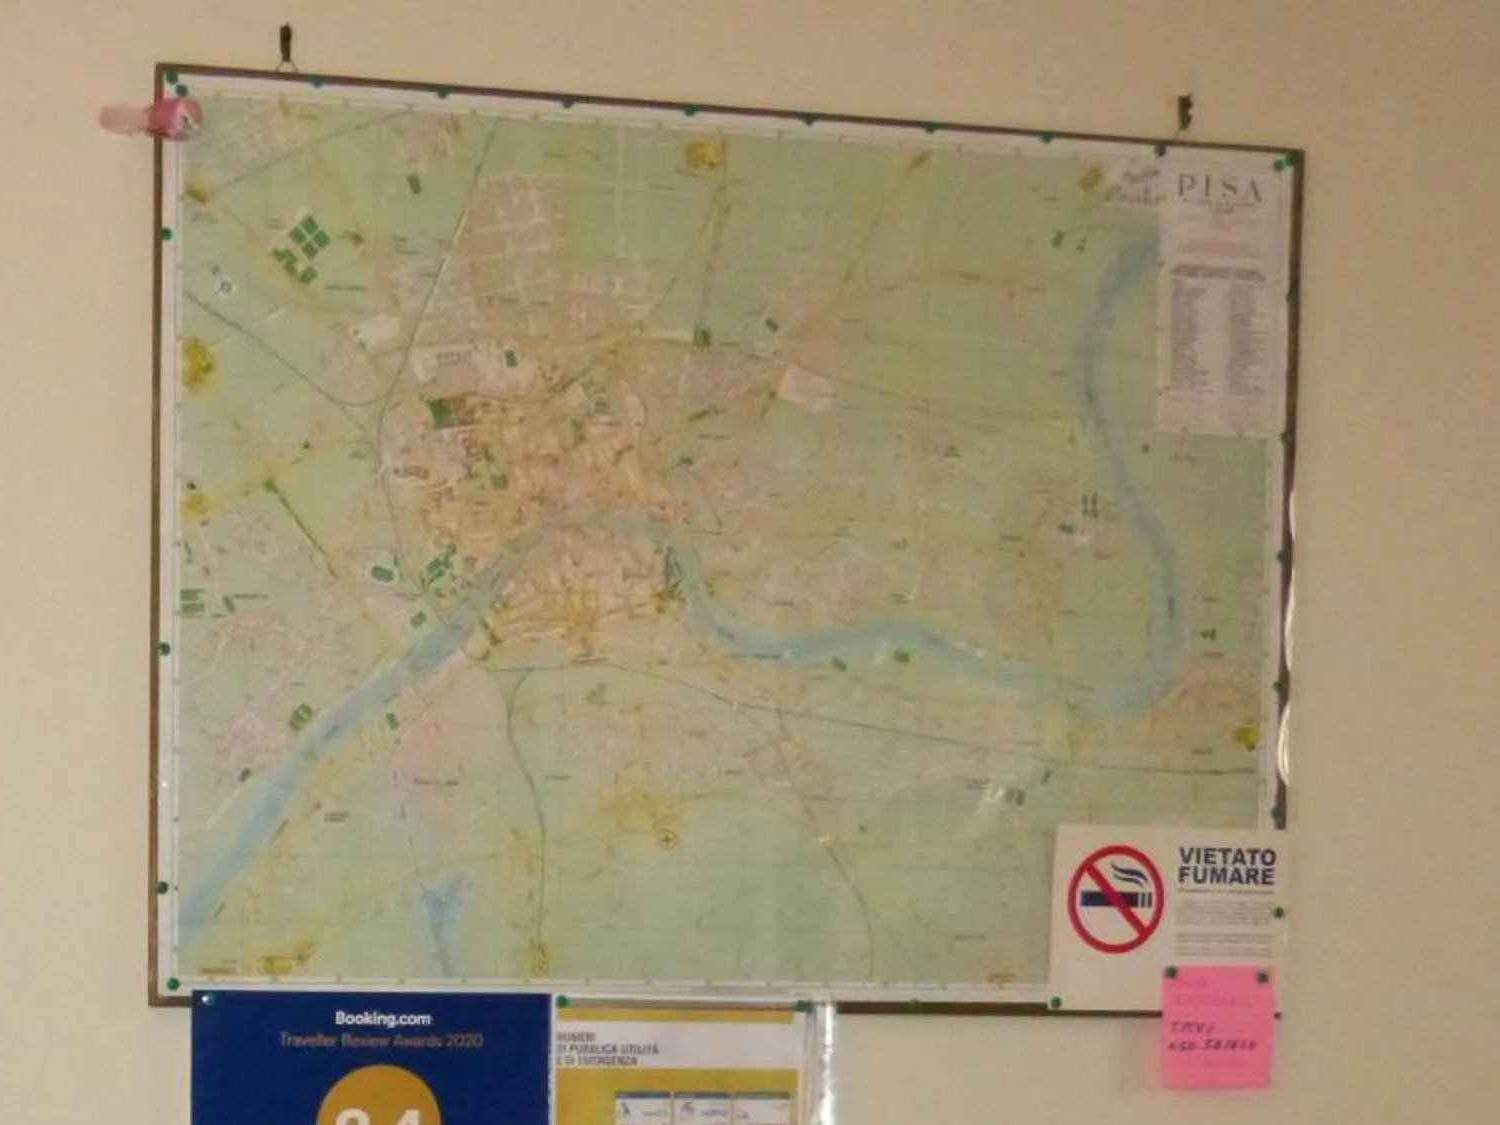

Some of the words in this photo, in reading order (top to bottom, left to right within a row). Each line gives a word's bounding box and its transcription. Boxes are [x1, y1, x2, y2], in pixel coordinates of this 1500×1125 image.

[1178, 173, 1263, 203] PISA
[1179, 847, 1277, 866] VIETATO
[1178, 867, 1276, 886] FUMARE
[335, 1011, 432, 1028] Booking.com
[281, 1032, 337, 1047] Traveller
[341, 1032, 391, 1047] Review
[393, 1033, 443, 1047] Awards
[445, 1033, 484, 1047] 2020
